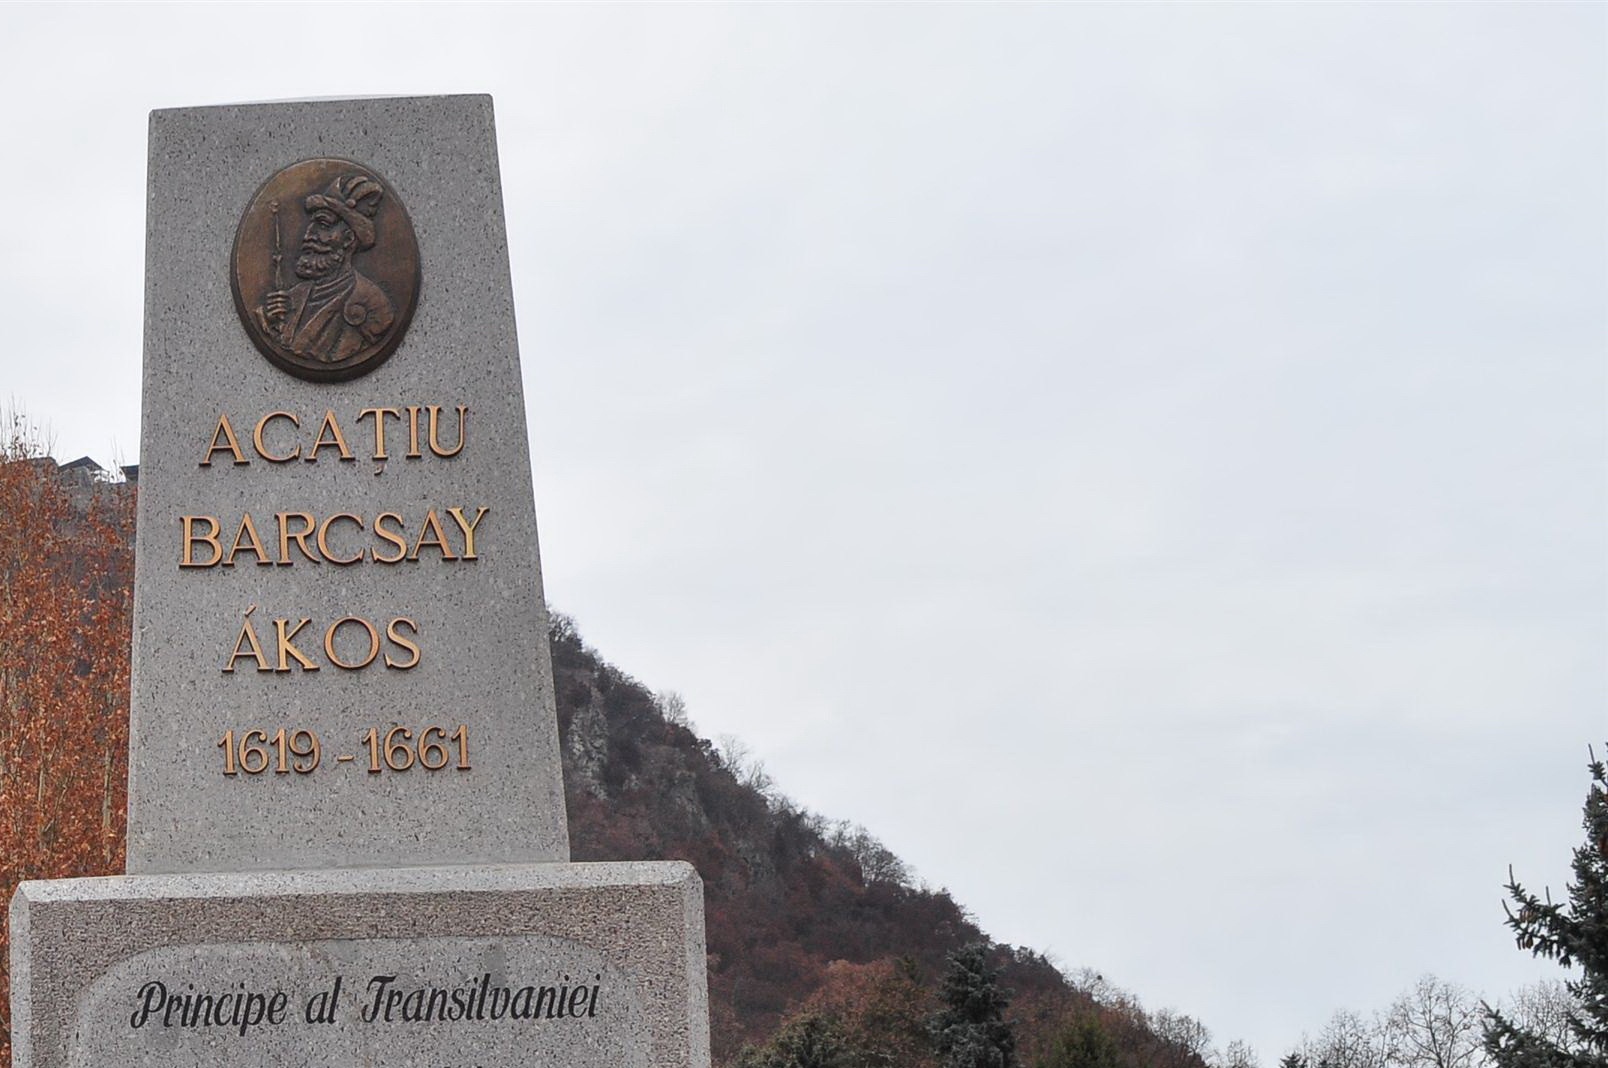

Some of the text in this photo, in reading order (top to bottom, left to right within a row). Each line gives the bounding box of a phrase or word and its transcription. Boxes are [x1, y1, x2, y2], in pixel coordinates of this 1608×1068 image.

[179, 507, 490, 568] BARCSAY
[222, 604, 421, 673] ÁKOS
[218, 728, 320, 774] 1619
[362, 724, 471, 773] 1661
[131, 974, 600, 1037] Principe al Transilvaniei
